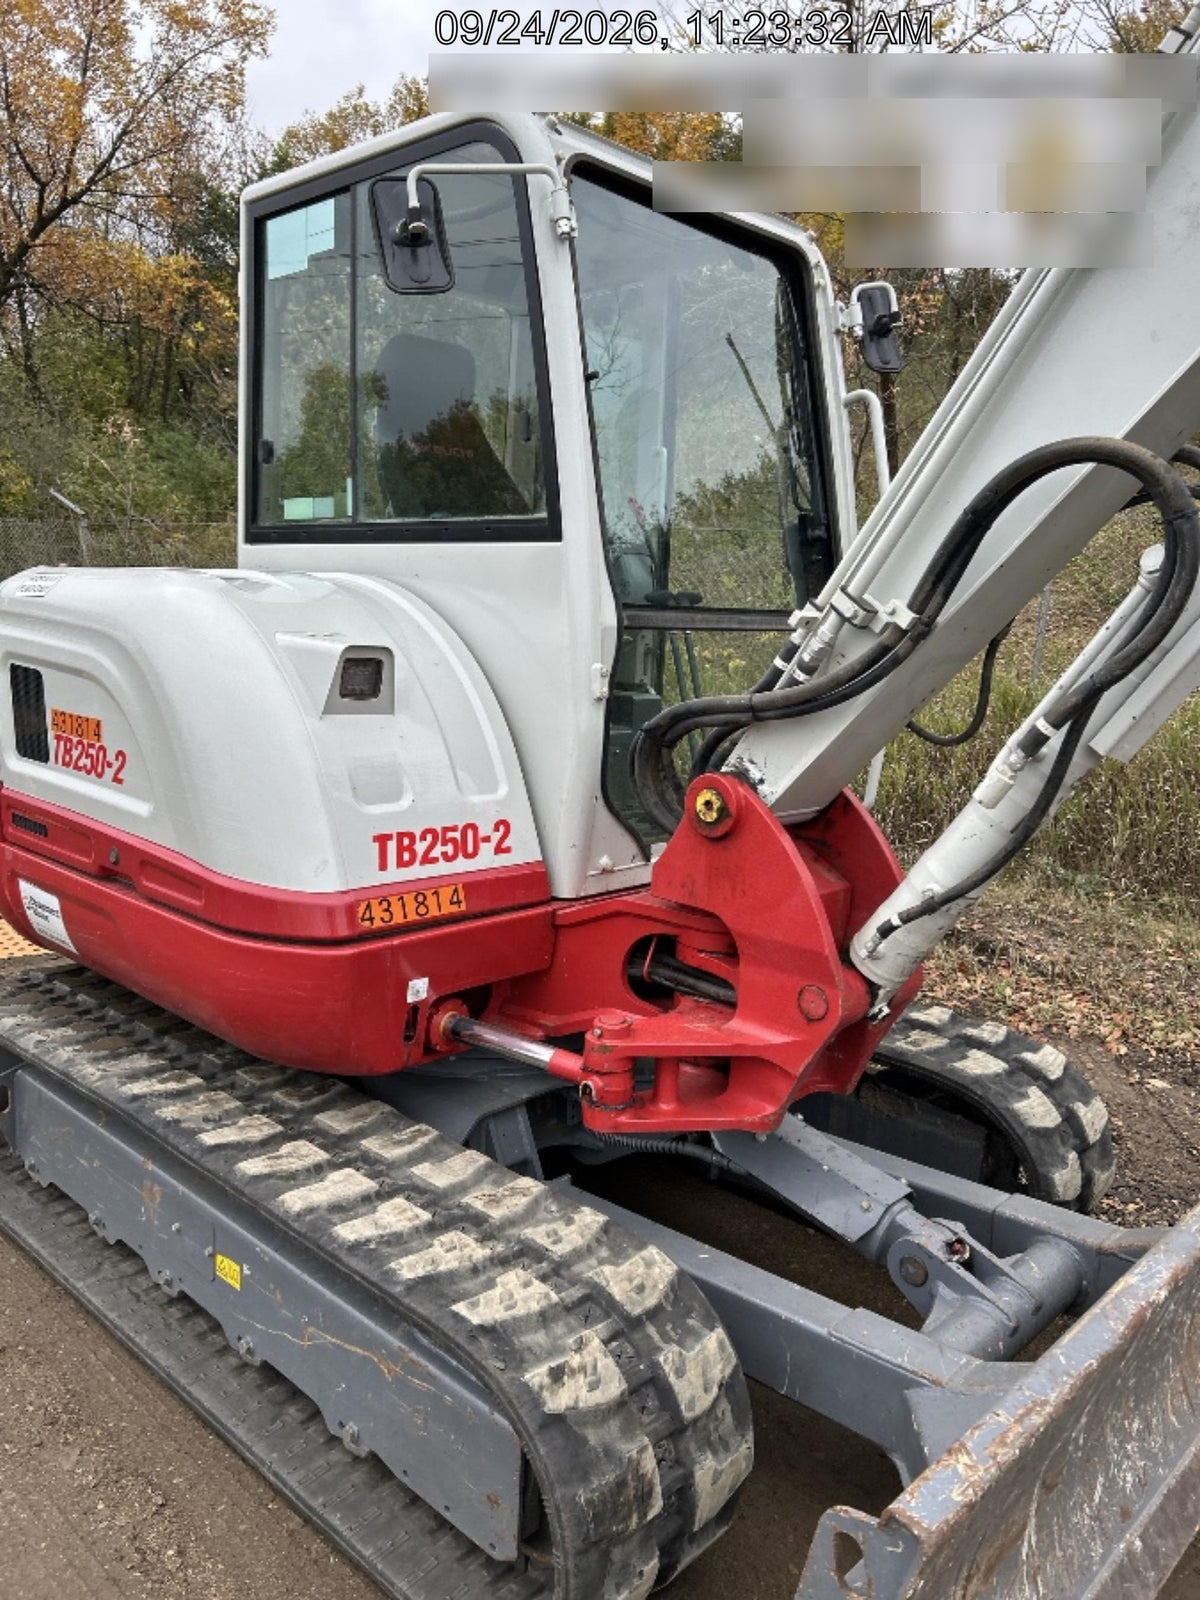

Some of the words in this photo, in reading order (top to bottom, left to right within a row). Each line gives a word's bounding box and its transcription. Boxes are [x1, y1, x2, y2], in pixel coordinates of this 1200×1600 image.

[52, 711, 101, 742] 431814
[54, 733, 127, 785] TB250-2
[372, 819, 512, 871] TB250-2
[360, 886, 463, 926] 431814
